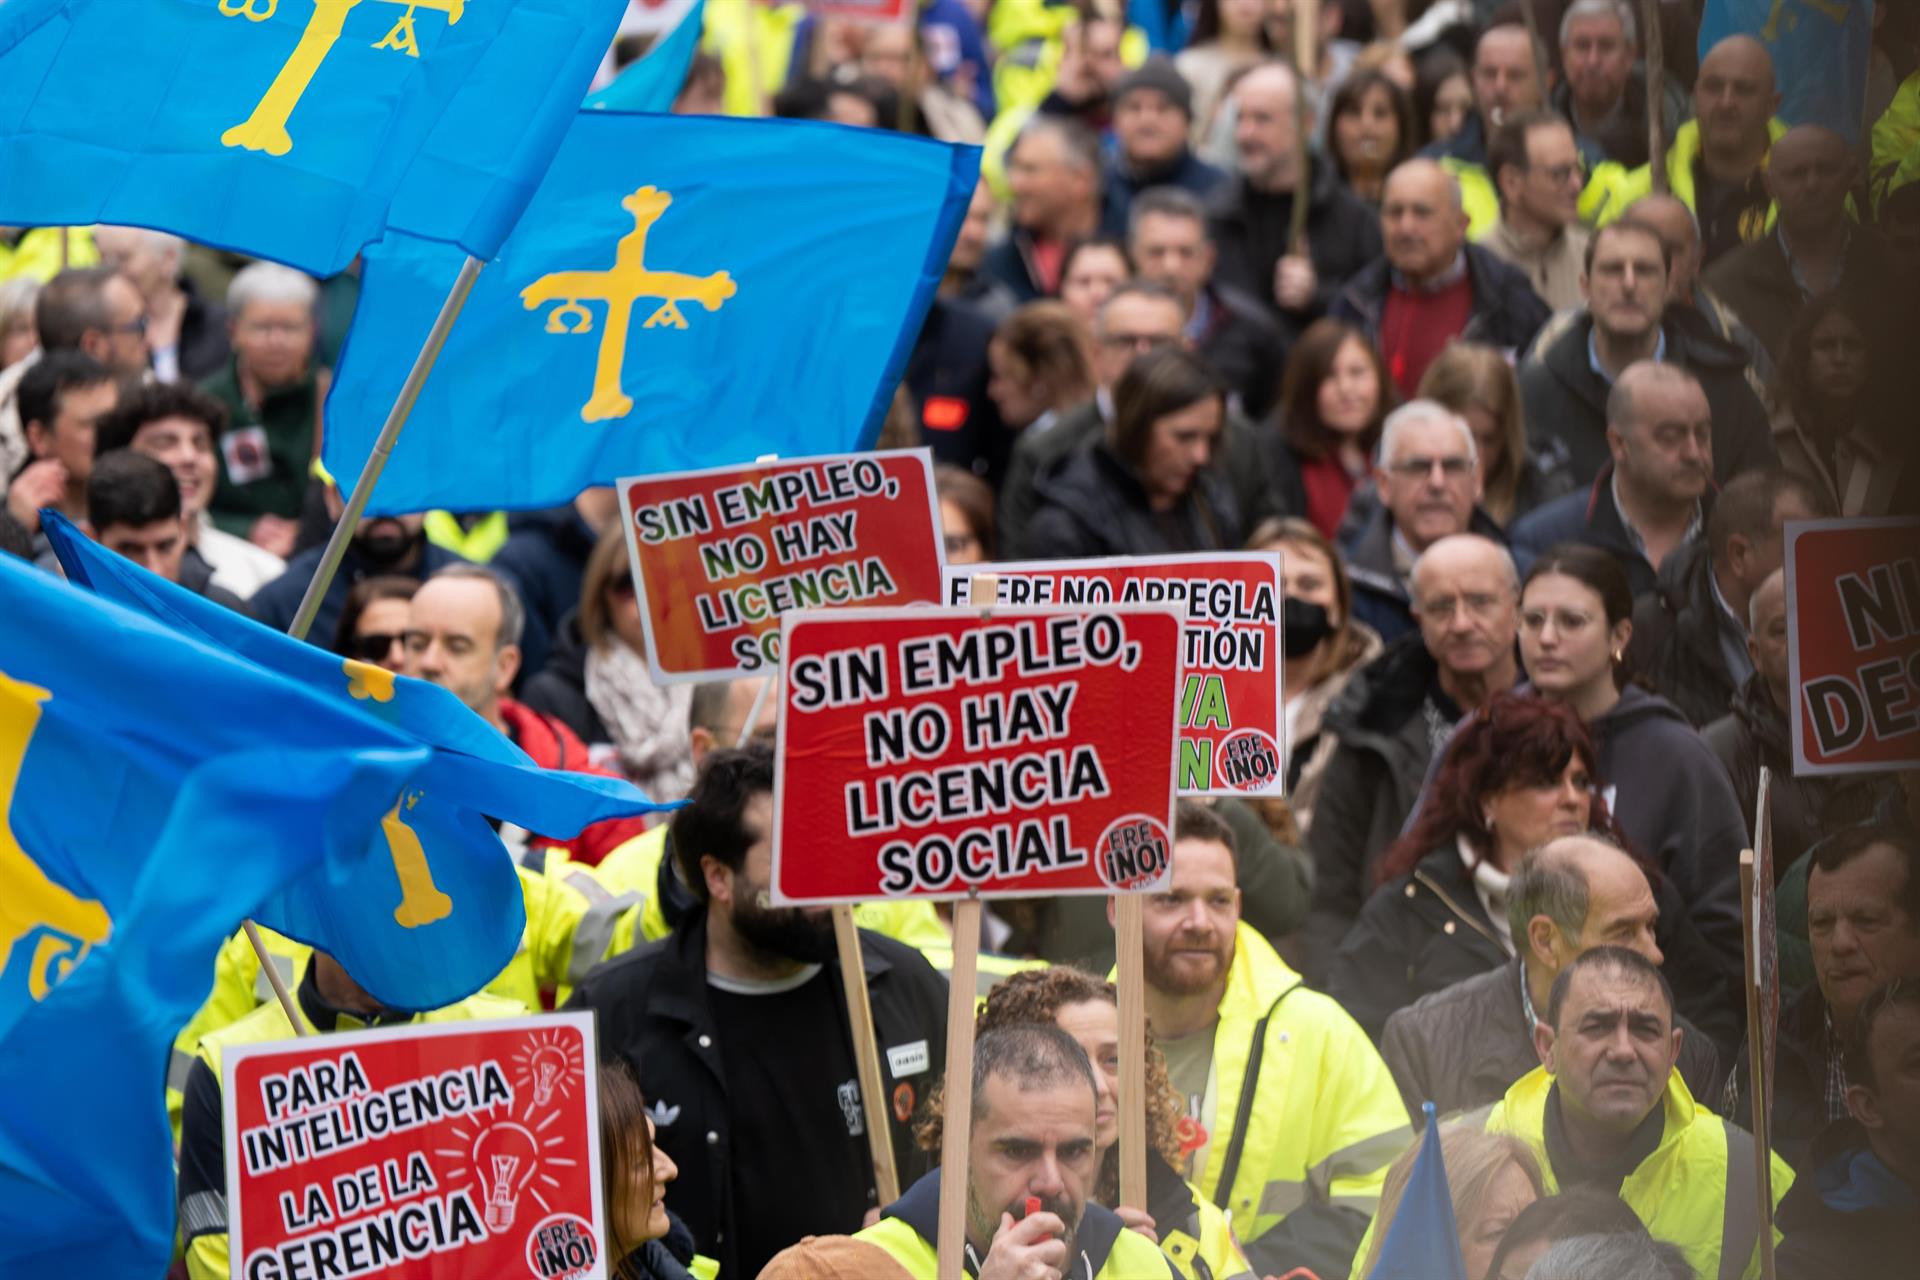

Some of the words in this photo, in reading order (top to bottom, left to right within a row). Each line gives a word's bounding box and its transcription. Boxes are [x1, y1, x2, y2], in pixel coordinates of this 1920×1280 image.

[637, 498, 709, 542] SIN
[716, 460, 898, 524] EMPLEO,
[701, 536, 764, 580] NO
[774, 514, 855, 562] HAY
[699, 560, 895, 629] LICENCIA
[1063, 580, 1110, 604] NO
[792, 648, 884, 708] SIN
[903, 614, 1138, 690] EMPLEO,
[868, 708, 948, 763] NO
[965, 686, 1073, 747] HAY
[1226, 734, 1264, 758] ERE
[848, 750, 1105, 832] LICENCIA
[1225, 751, 1277, 785] ¡NO!
[882, 819, 1084, 892] SOCIAL
[1106, 840, 1167, 883] ¡NO!
[1109, 821, 1151, 850] ERE
[245, 1065, 510, 1170] INTELIGENCIA
[264, 1056, 367, 1117] PARA
[283, 1189, 329, 1229] LA
[335, 1170, 381, 1212] DE
[387, 1155, 433, 1196] LA
[249, 1196, 482, 1280] GERENCIA
[537, 1220, 580, 1248] ERE
[537, 1236, 596, 1277] ¡NO!
